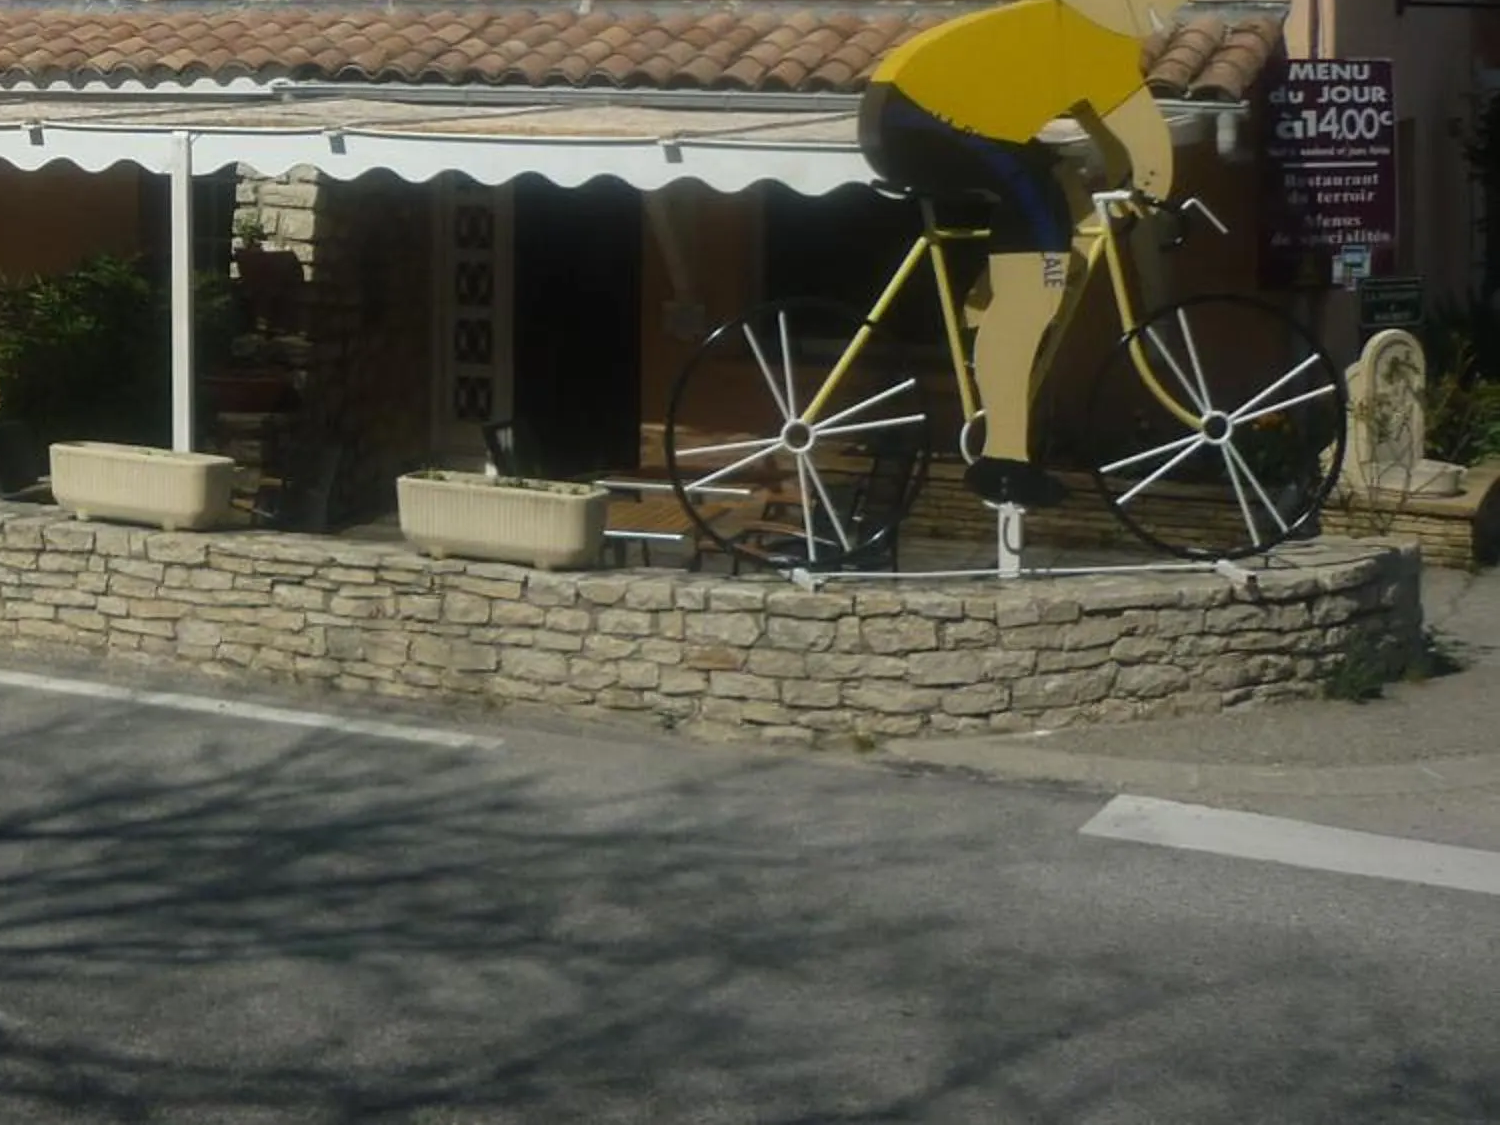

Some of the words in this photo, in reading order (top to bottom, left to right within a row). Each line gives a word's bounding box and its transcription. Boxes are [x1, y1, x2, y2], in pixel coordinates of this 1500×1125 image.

[1288, 63, 1371, 81] MENU
[1268, 85, 1305, 104] du
[1316, 85, 1388, 104] JOUR
[1316, 188, 1377, 204] terroir
